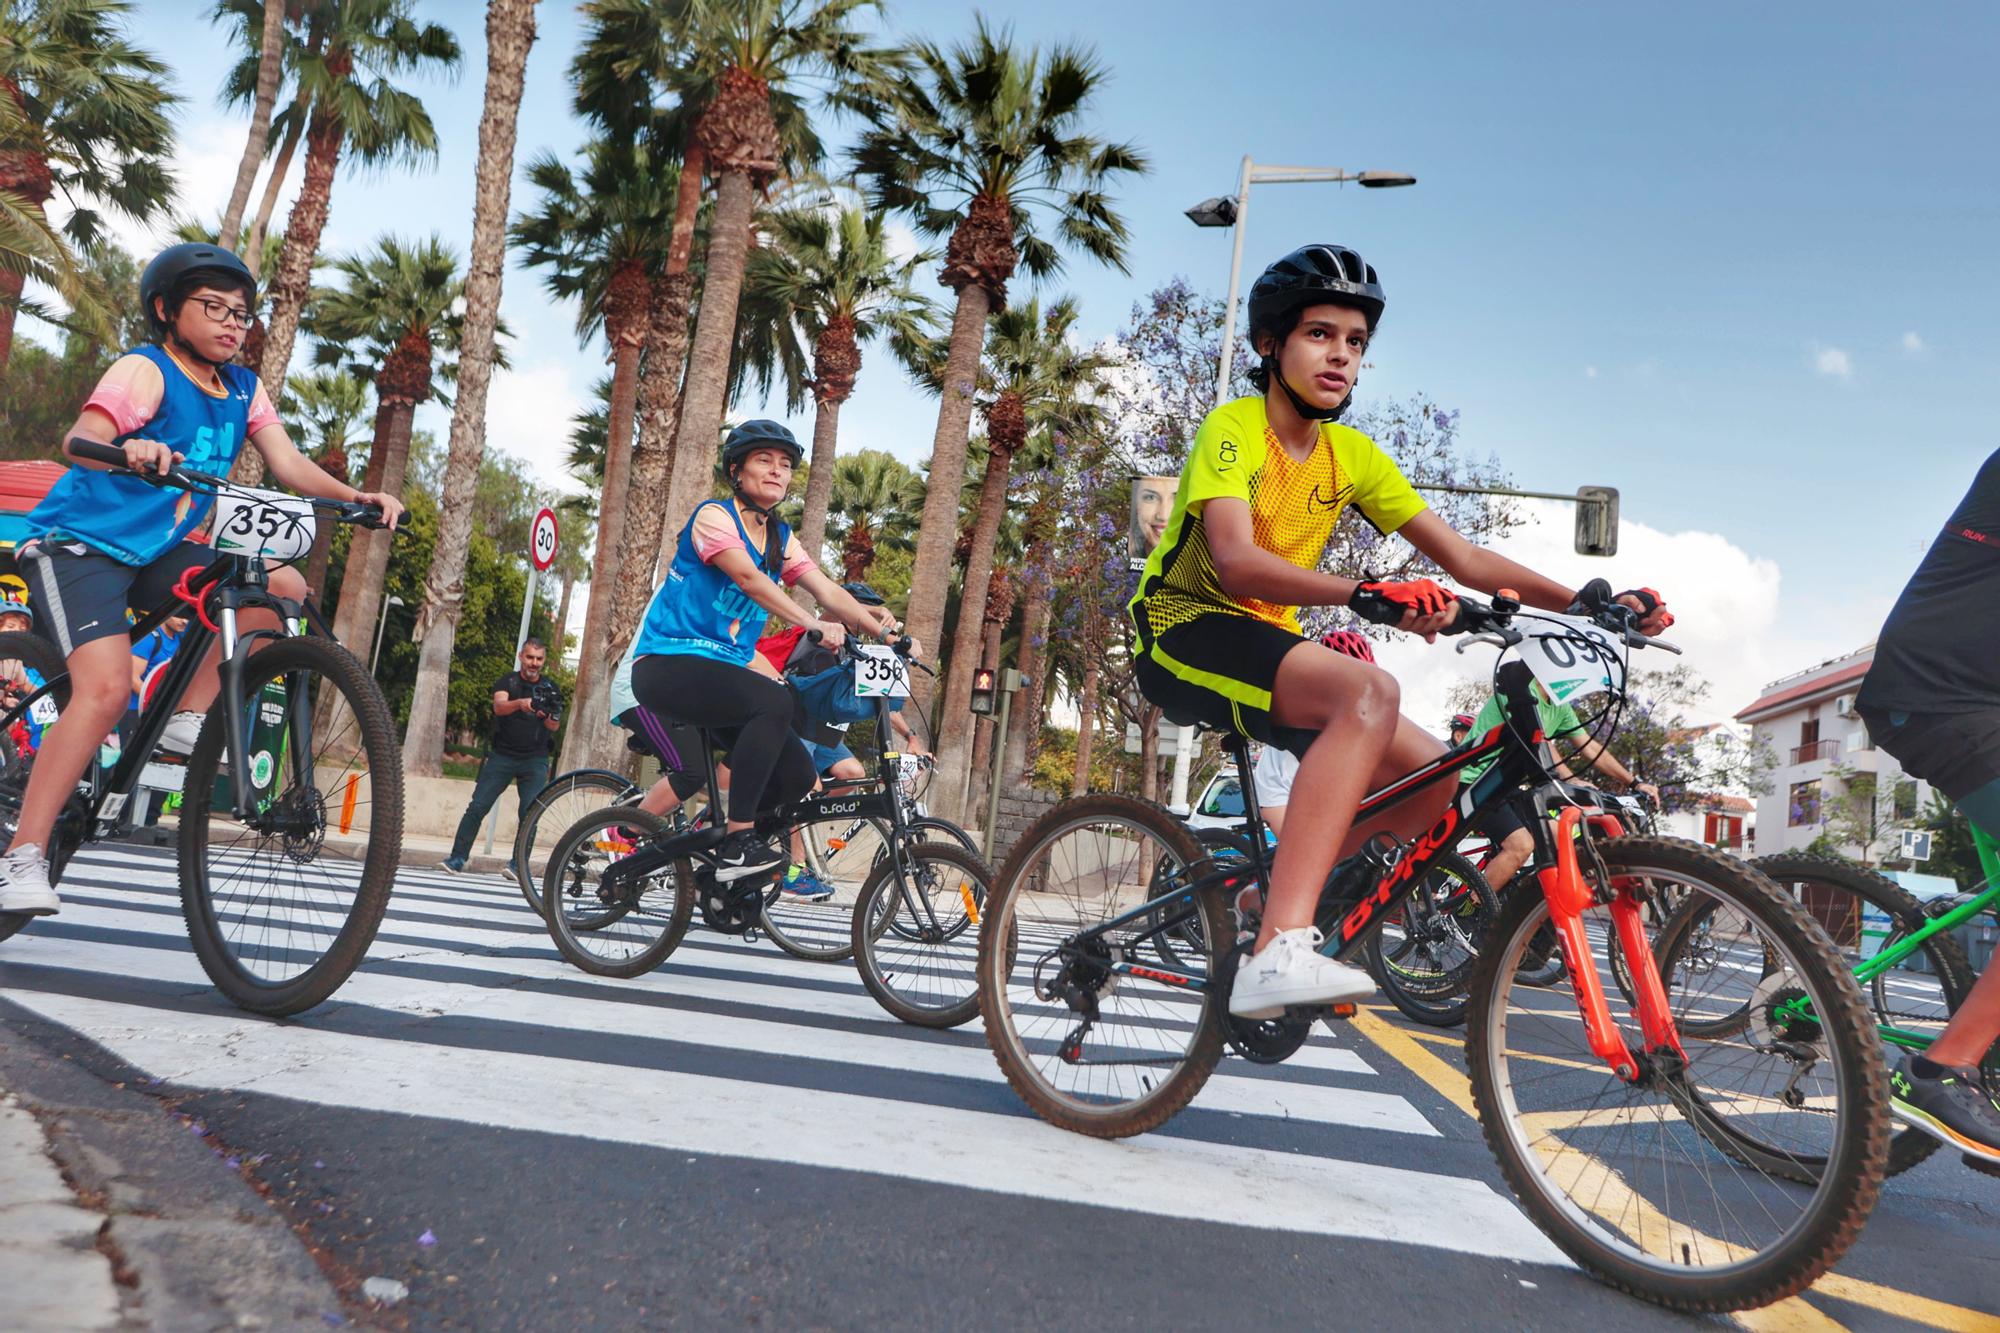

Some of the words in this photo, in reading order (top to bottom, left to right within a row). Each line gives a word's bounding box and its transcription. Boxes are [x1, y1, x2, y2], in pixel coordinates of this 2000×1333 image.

[231, 504, 302, 540] 357
[538, 527, 553, 551] 30
[864, 657, 903, 681] 356
[1910, 833, 1923, 847] P
[1342, 807, 1458, 942] B-PRO
